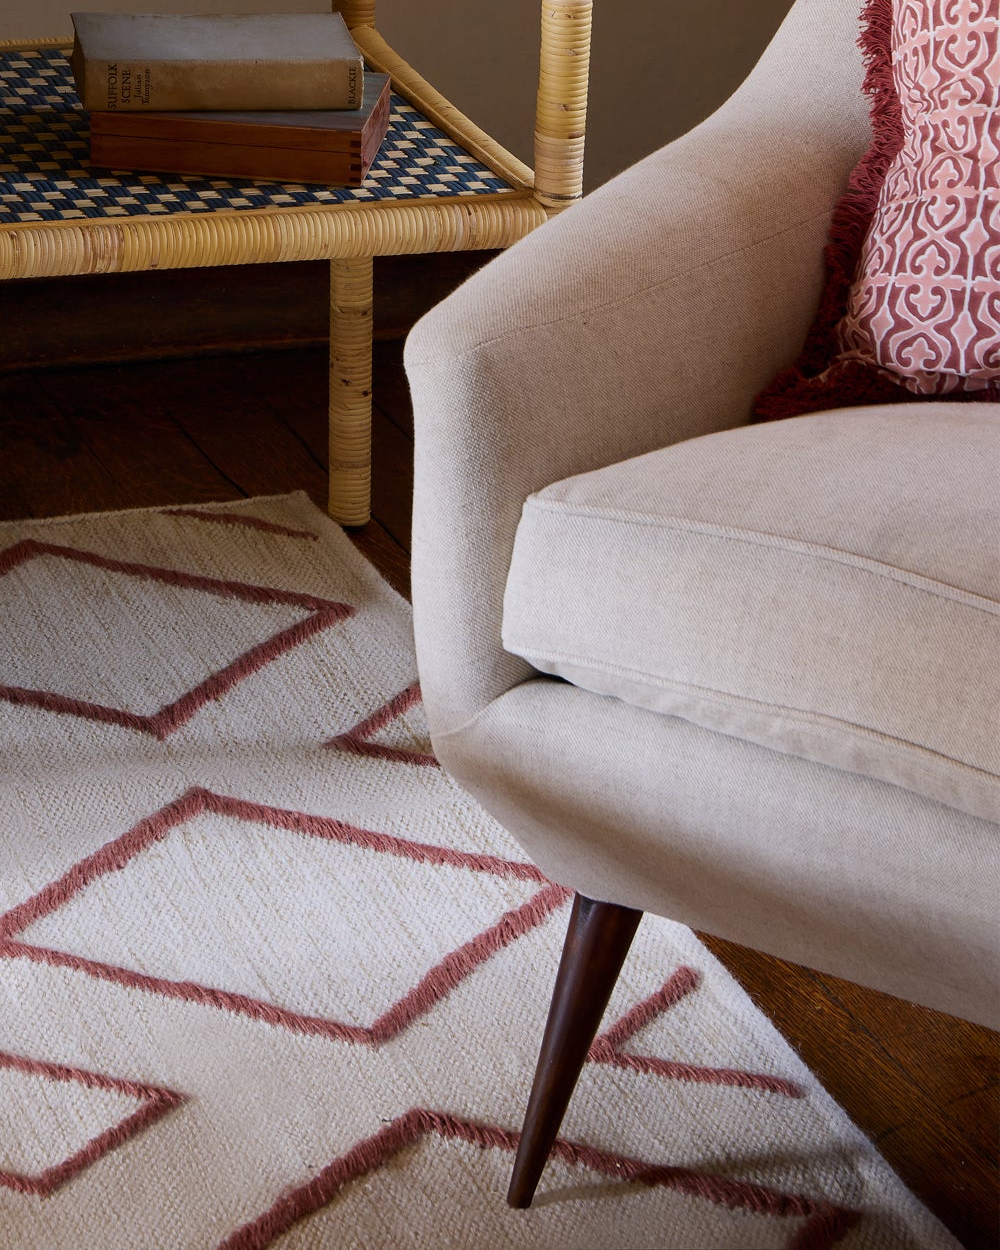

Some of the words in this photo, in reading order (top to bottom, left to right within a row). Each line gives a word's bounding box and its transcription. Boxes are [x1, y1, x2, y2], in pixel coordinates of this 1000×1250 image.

[108, 63, 118, 109] SUFFOLK
[122, 69, 131, 104] SCENE
[134, 74, 142, 98] Julian
[348, 66, 356, 104] BLACKIE
